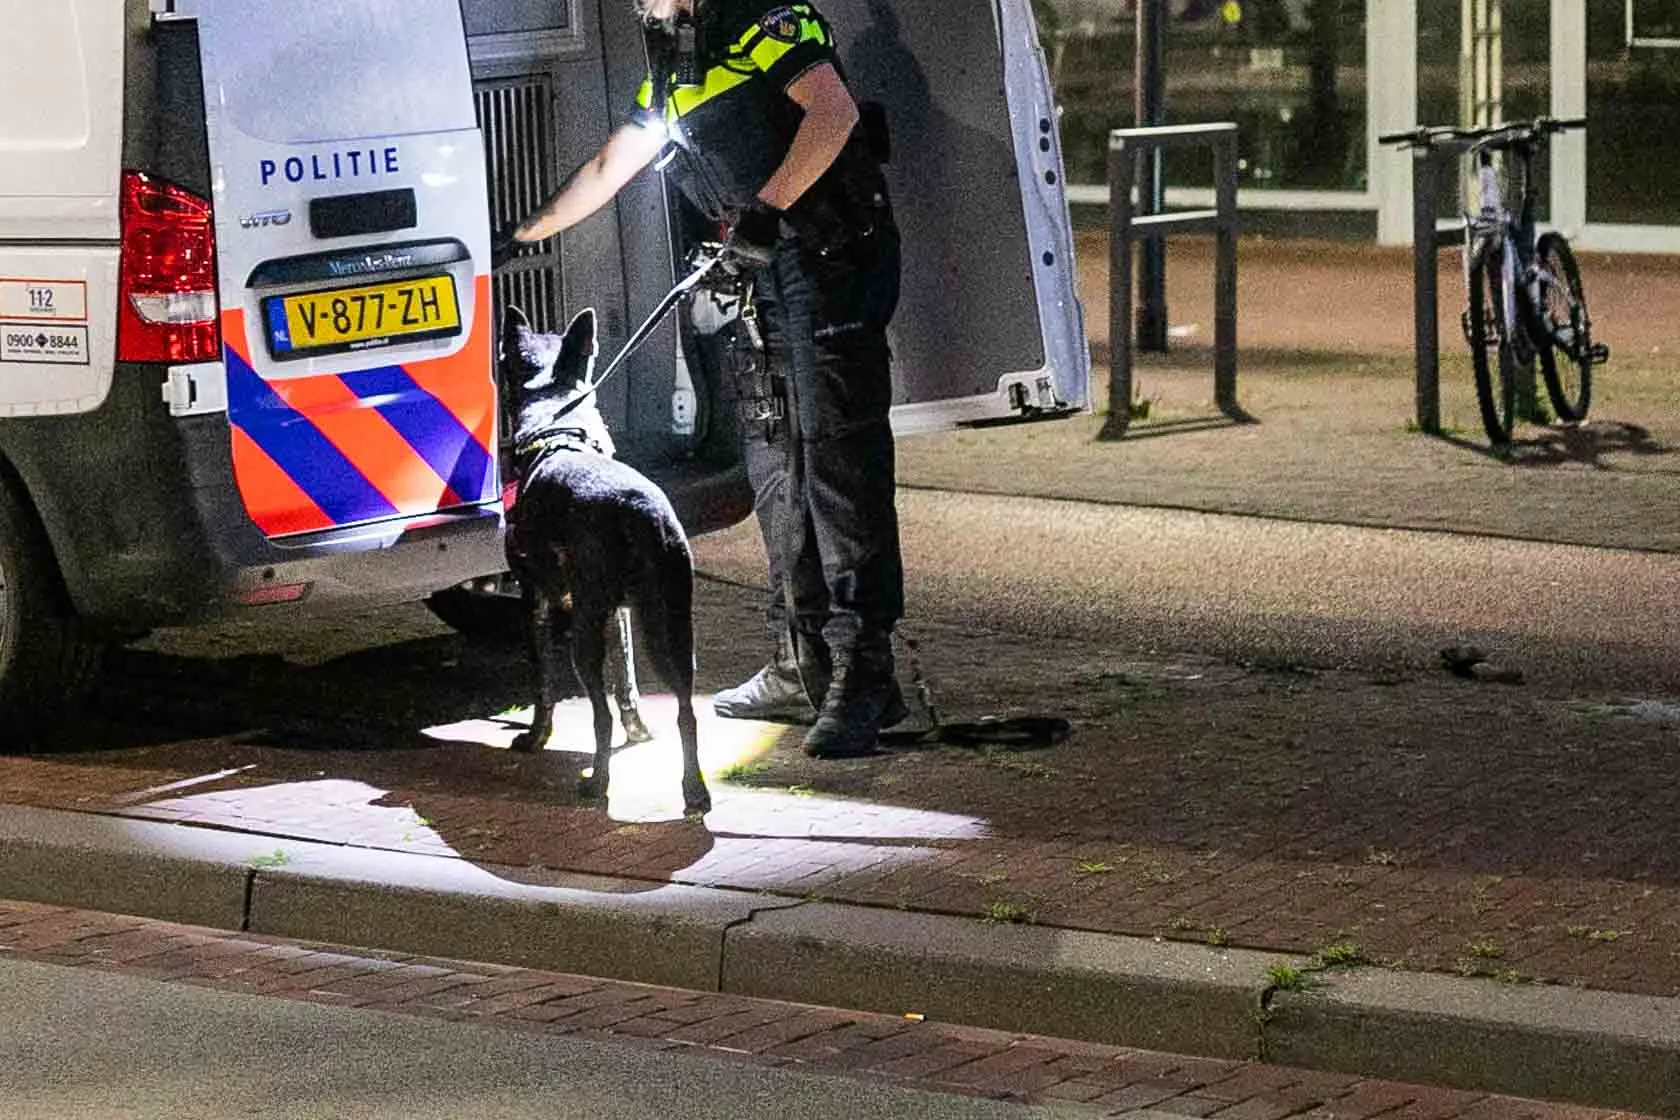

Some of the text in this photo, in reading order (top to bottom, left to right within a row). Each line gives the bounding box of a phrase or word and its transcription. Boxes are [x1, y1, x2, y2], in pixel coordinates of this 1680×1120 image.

[260, 147, 399, 185] POLITIE
[29, 289, 53, 307] 112
[297, 286, 441, 338] V-877-ZH
[7, 334, 78, 348] 0900 8844
